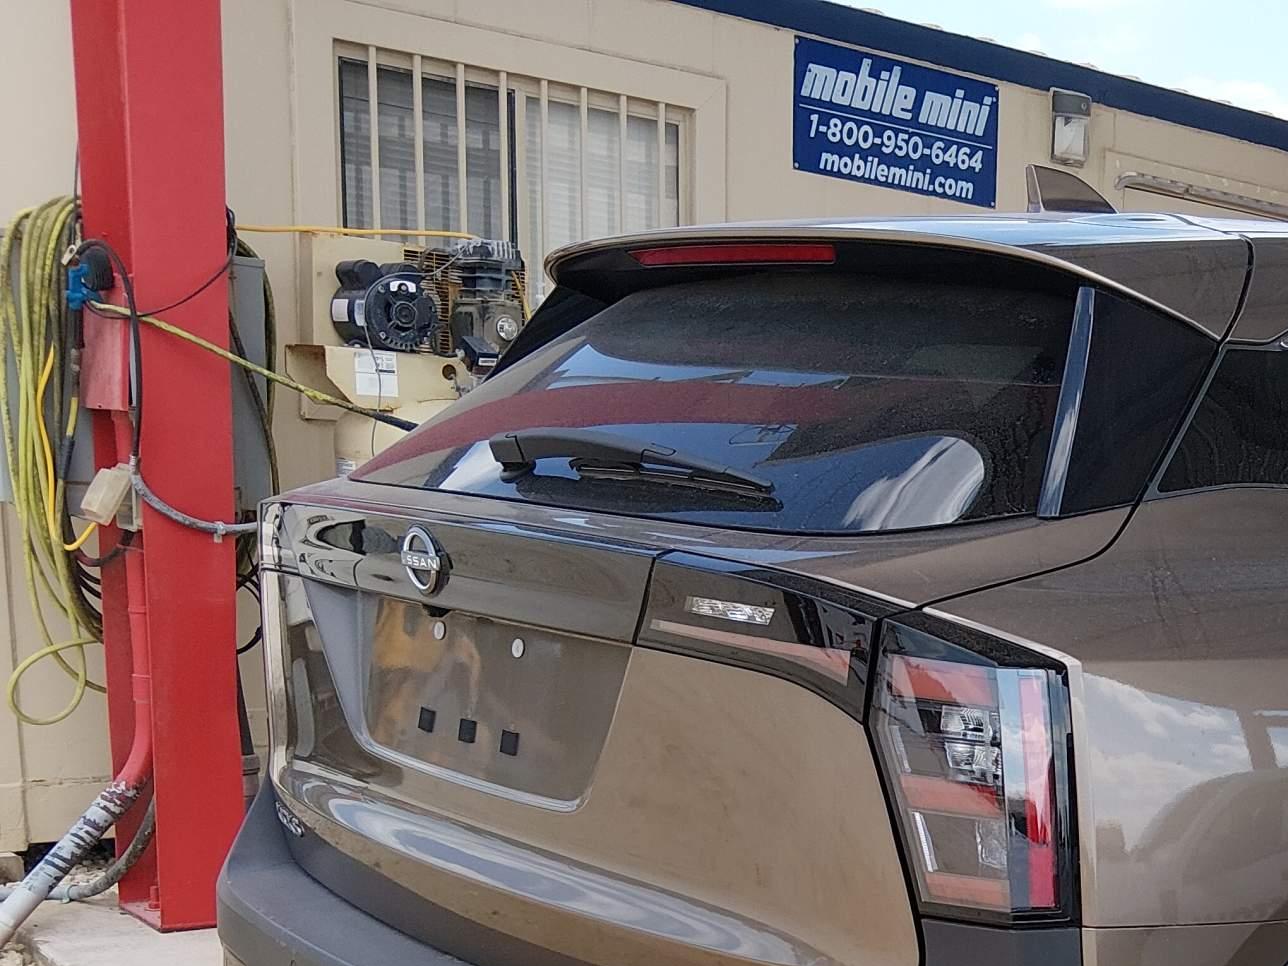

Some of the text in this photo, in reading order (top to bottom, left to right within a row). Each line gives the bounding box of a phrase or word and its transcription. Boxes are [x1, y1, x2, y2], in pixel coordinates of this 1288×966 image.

[800, 57, 993, 137] mobile mini
[808, 113, 984, 173] 1-800-950-6464
[818, 151, 975, 200] mobilemini.com
[402, 552, 438, 570] SSAN
